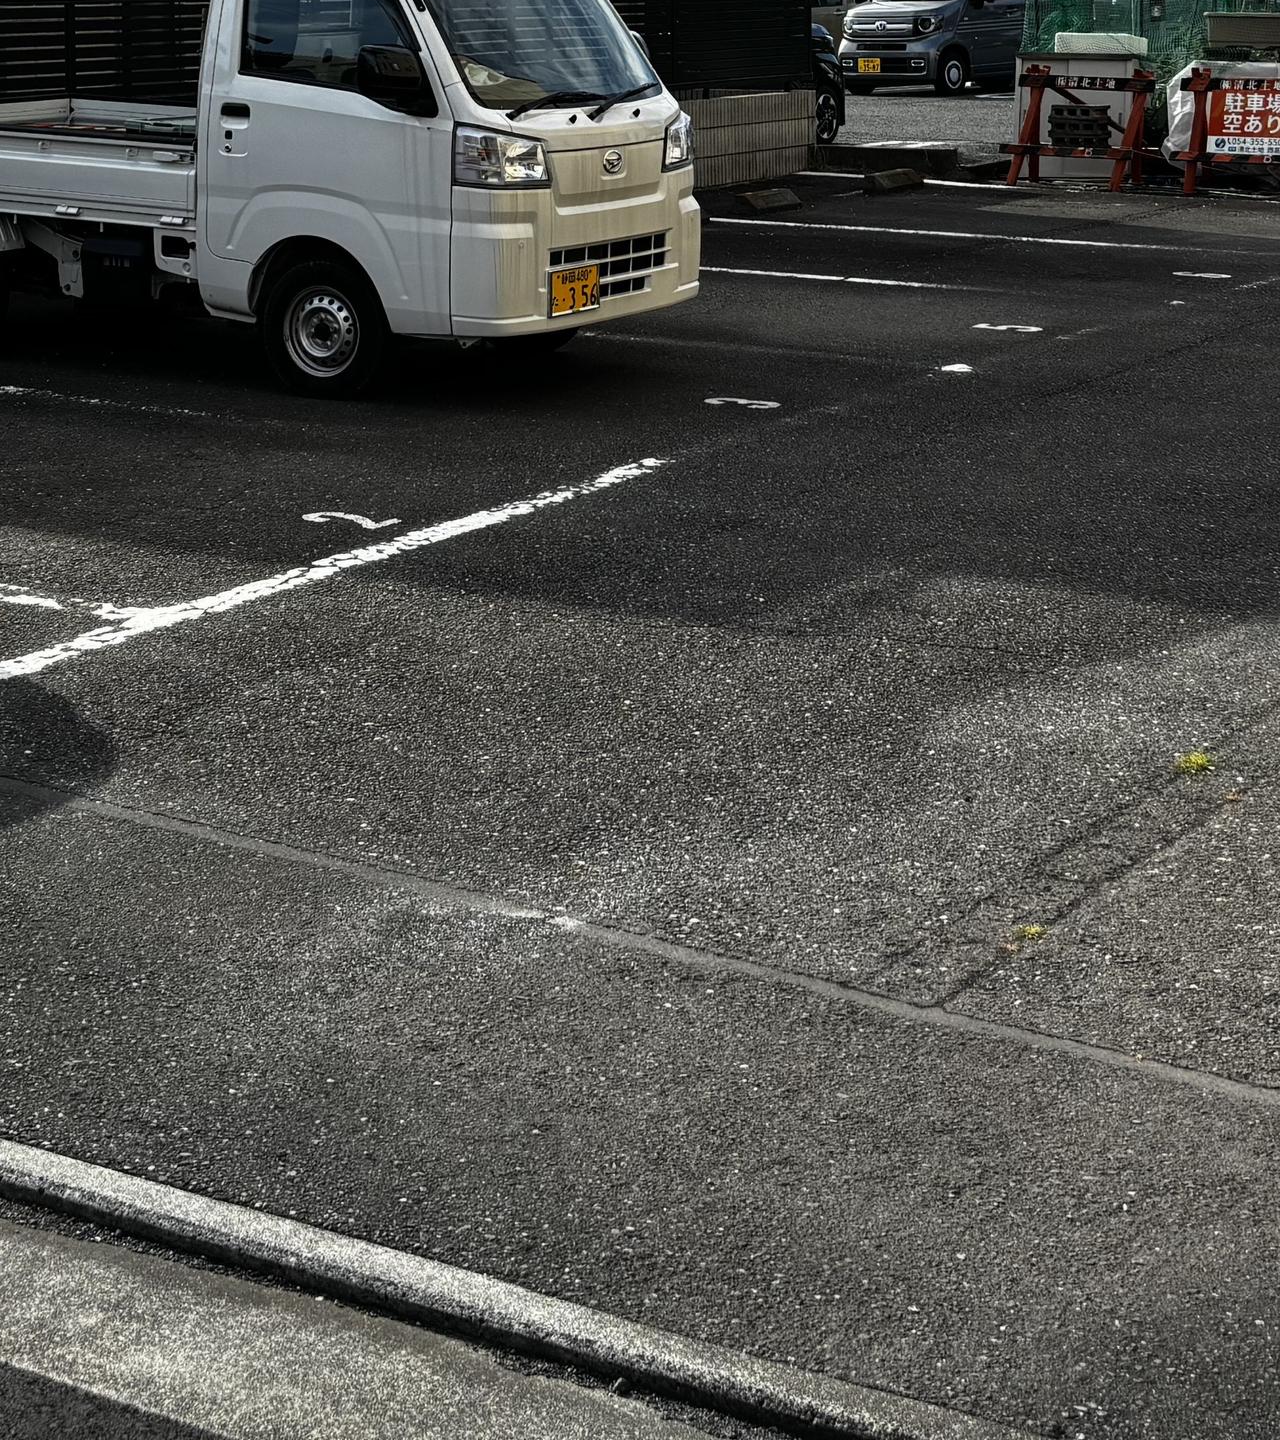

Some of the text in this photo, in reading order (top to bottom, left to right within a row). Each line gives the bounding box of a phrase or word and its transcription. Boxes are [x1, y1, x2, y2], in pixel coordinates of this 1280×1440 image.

[1222, 113, 1280, 134] 空あり
[302, 512, 402, 530] 2
